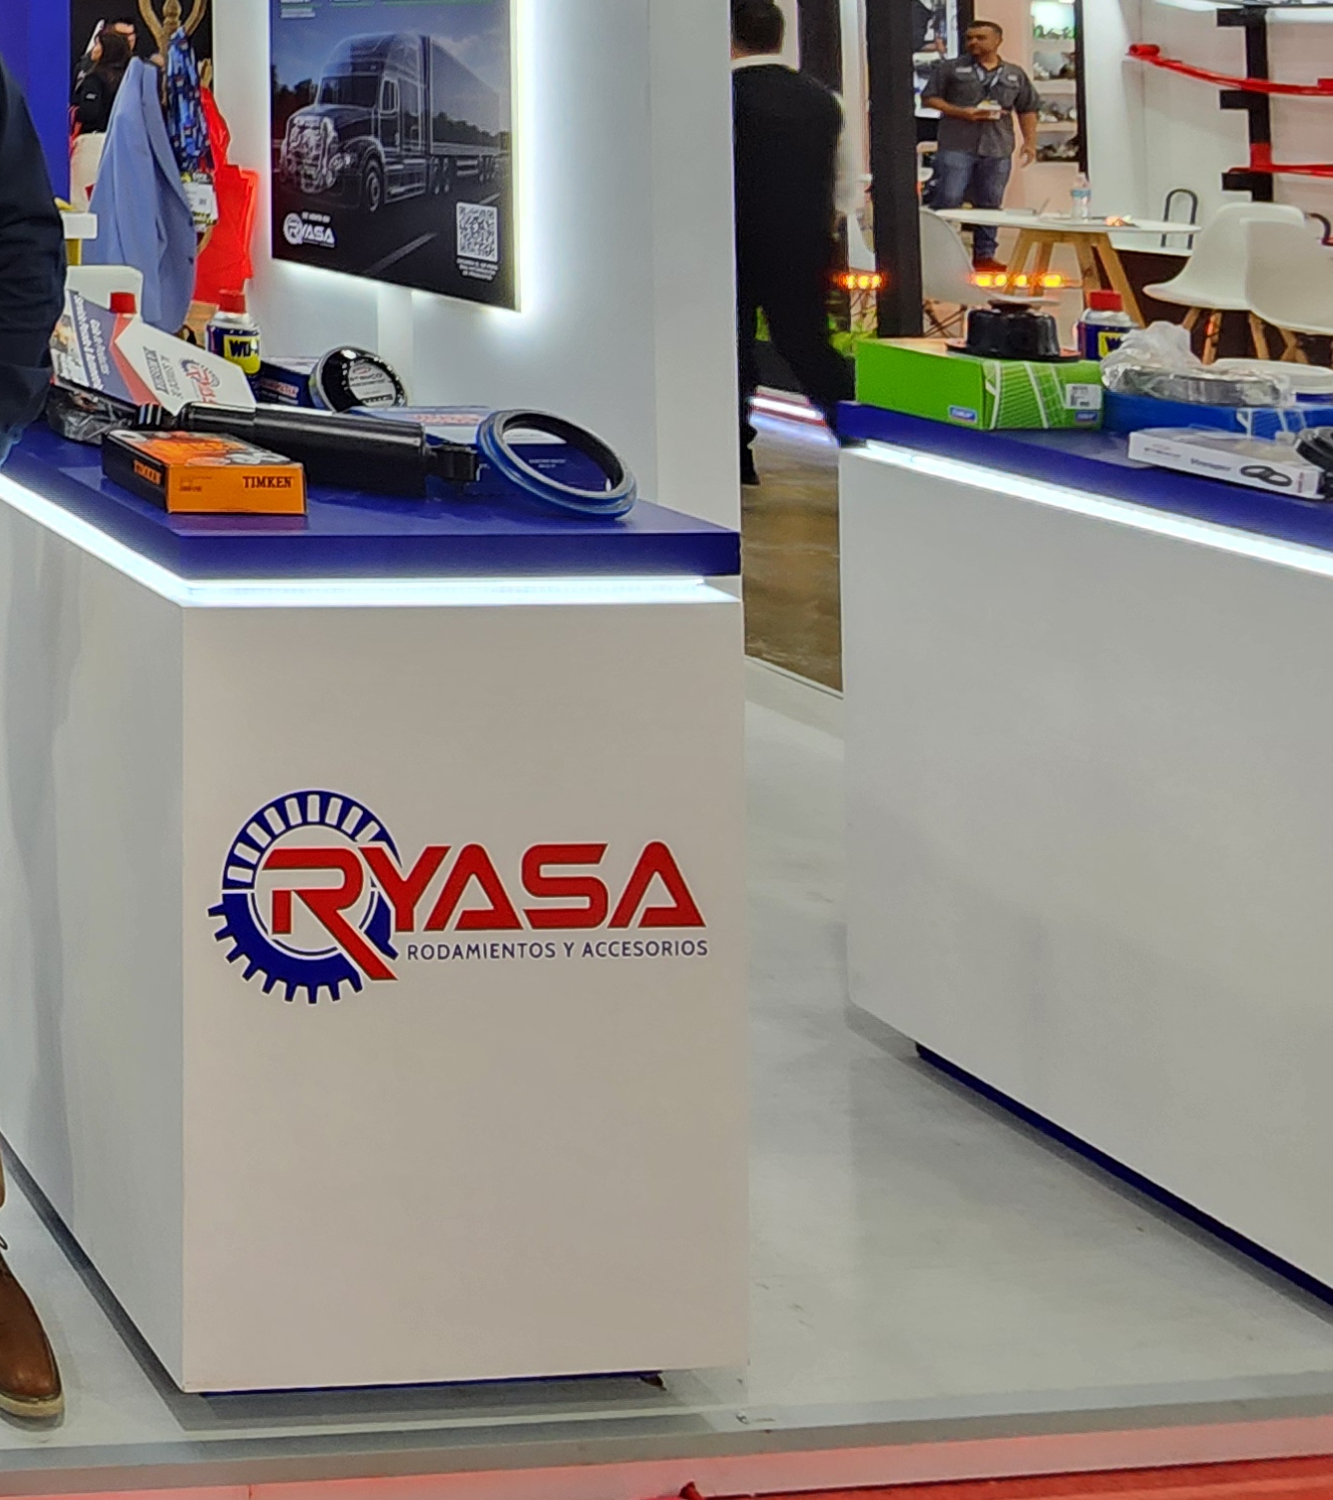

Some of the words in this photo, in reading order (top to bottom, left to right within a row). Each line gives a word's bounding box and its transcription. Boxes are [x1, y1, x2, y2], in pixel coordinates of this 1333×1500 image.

[242, 476, 292, 489] TIMKEN
[261, 841, 706, 980] RYASA
[407, 942, 556, 962] RODAMIENTOS
[563, 942, 574, 960] Y
[582, 940, 708, 958] ACCESORIOS
